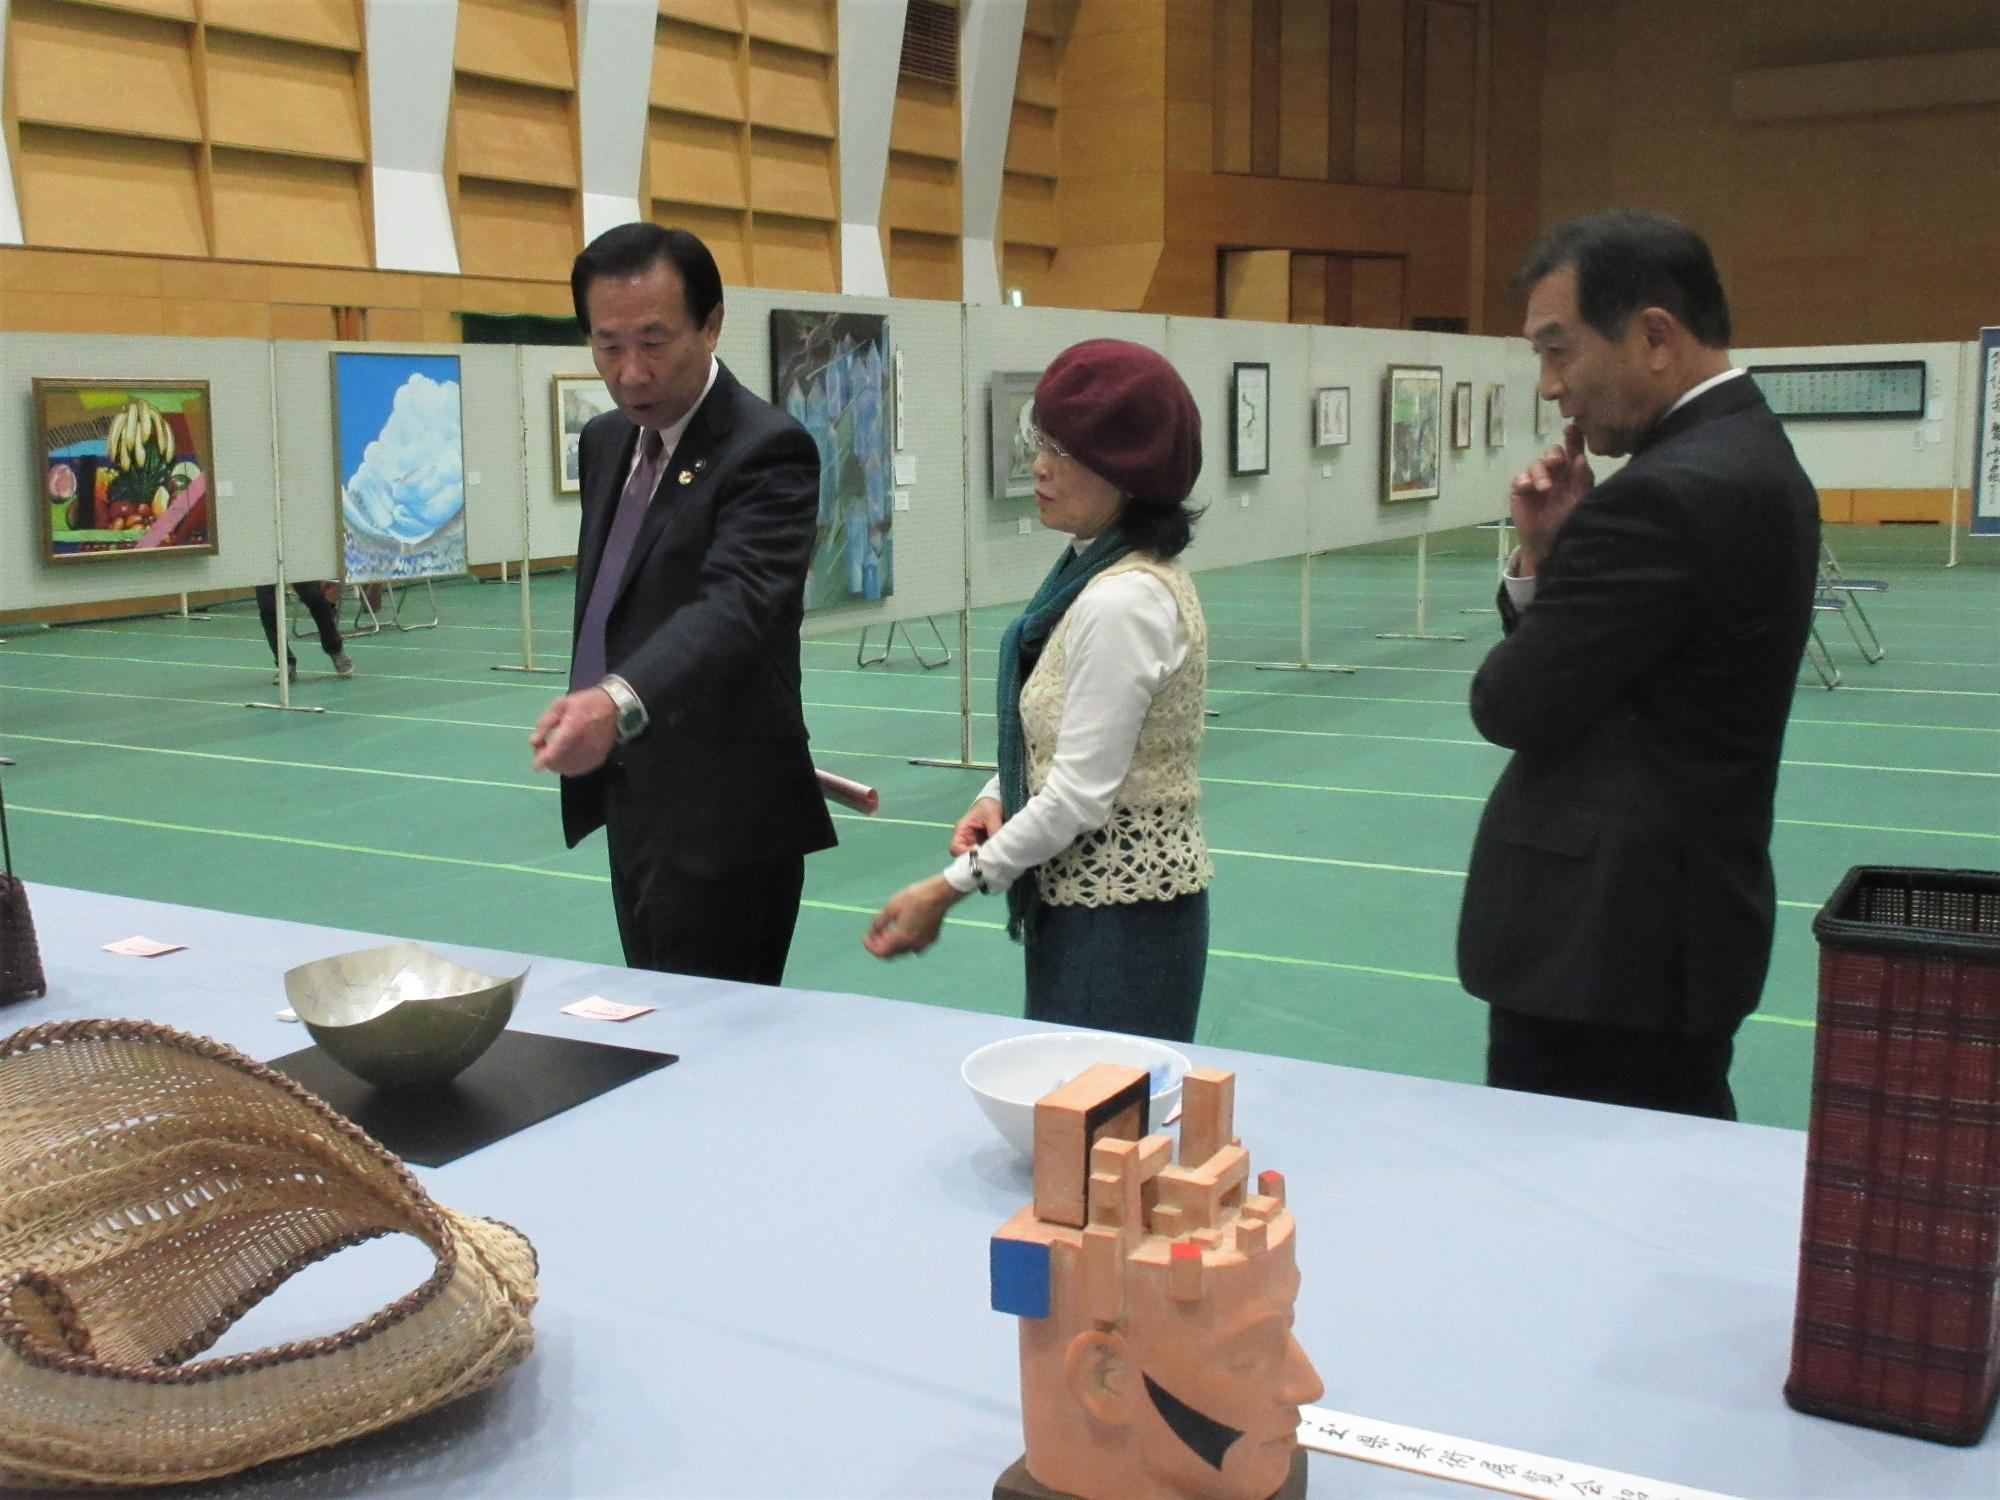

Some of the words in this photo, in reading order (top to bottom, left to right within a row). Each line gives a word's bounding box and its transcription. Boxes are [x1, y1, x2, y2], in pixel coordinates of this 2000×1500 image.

[1303, 1420, 1649, 1500] 玉県美術展覧会
